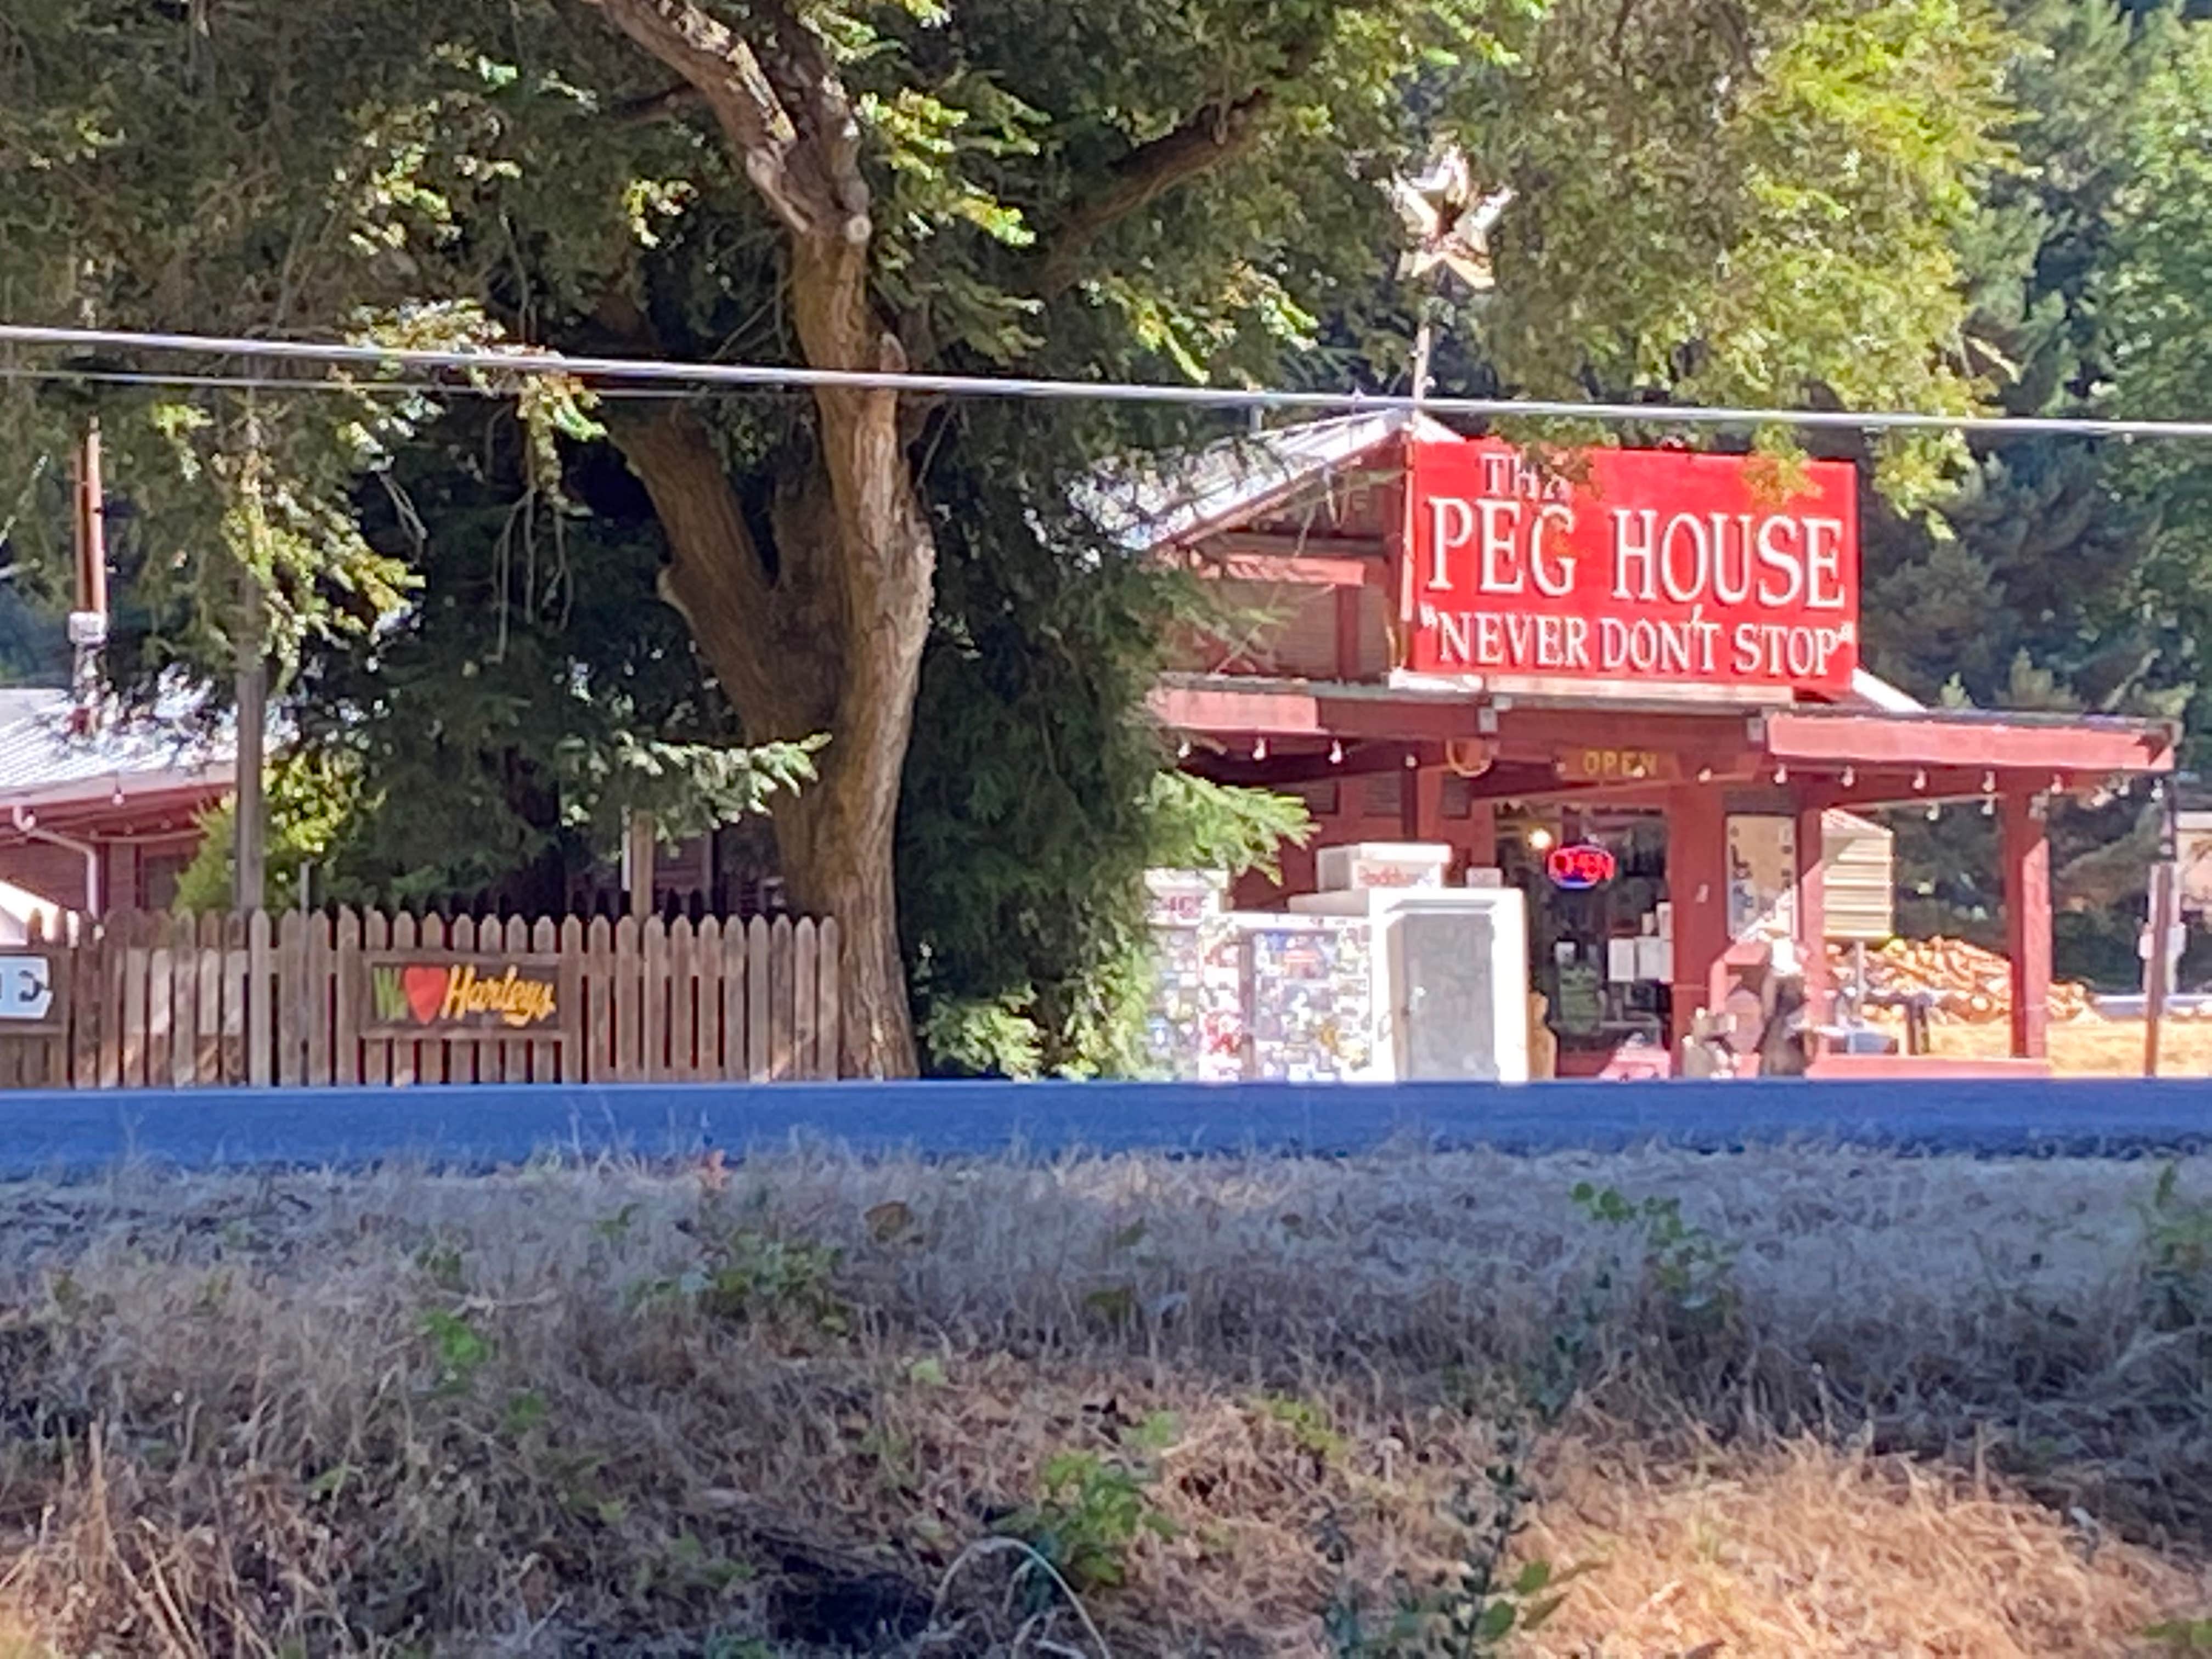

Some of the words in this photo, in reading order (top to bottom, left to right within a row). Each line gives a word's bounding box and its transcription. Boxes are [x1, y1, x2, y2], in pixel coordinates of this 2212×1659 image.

[1426, 496, 1577, 596] PEG
[1612, 509, 1845, 608] HOUSE
[1598, 603, 1722, 672] DON'T
[1584, 751, 1657, 778] OPEN
[1549, 850, 1615, 881] OPEN
[440, 964, 556, 1026] Harleys
